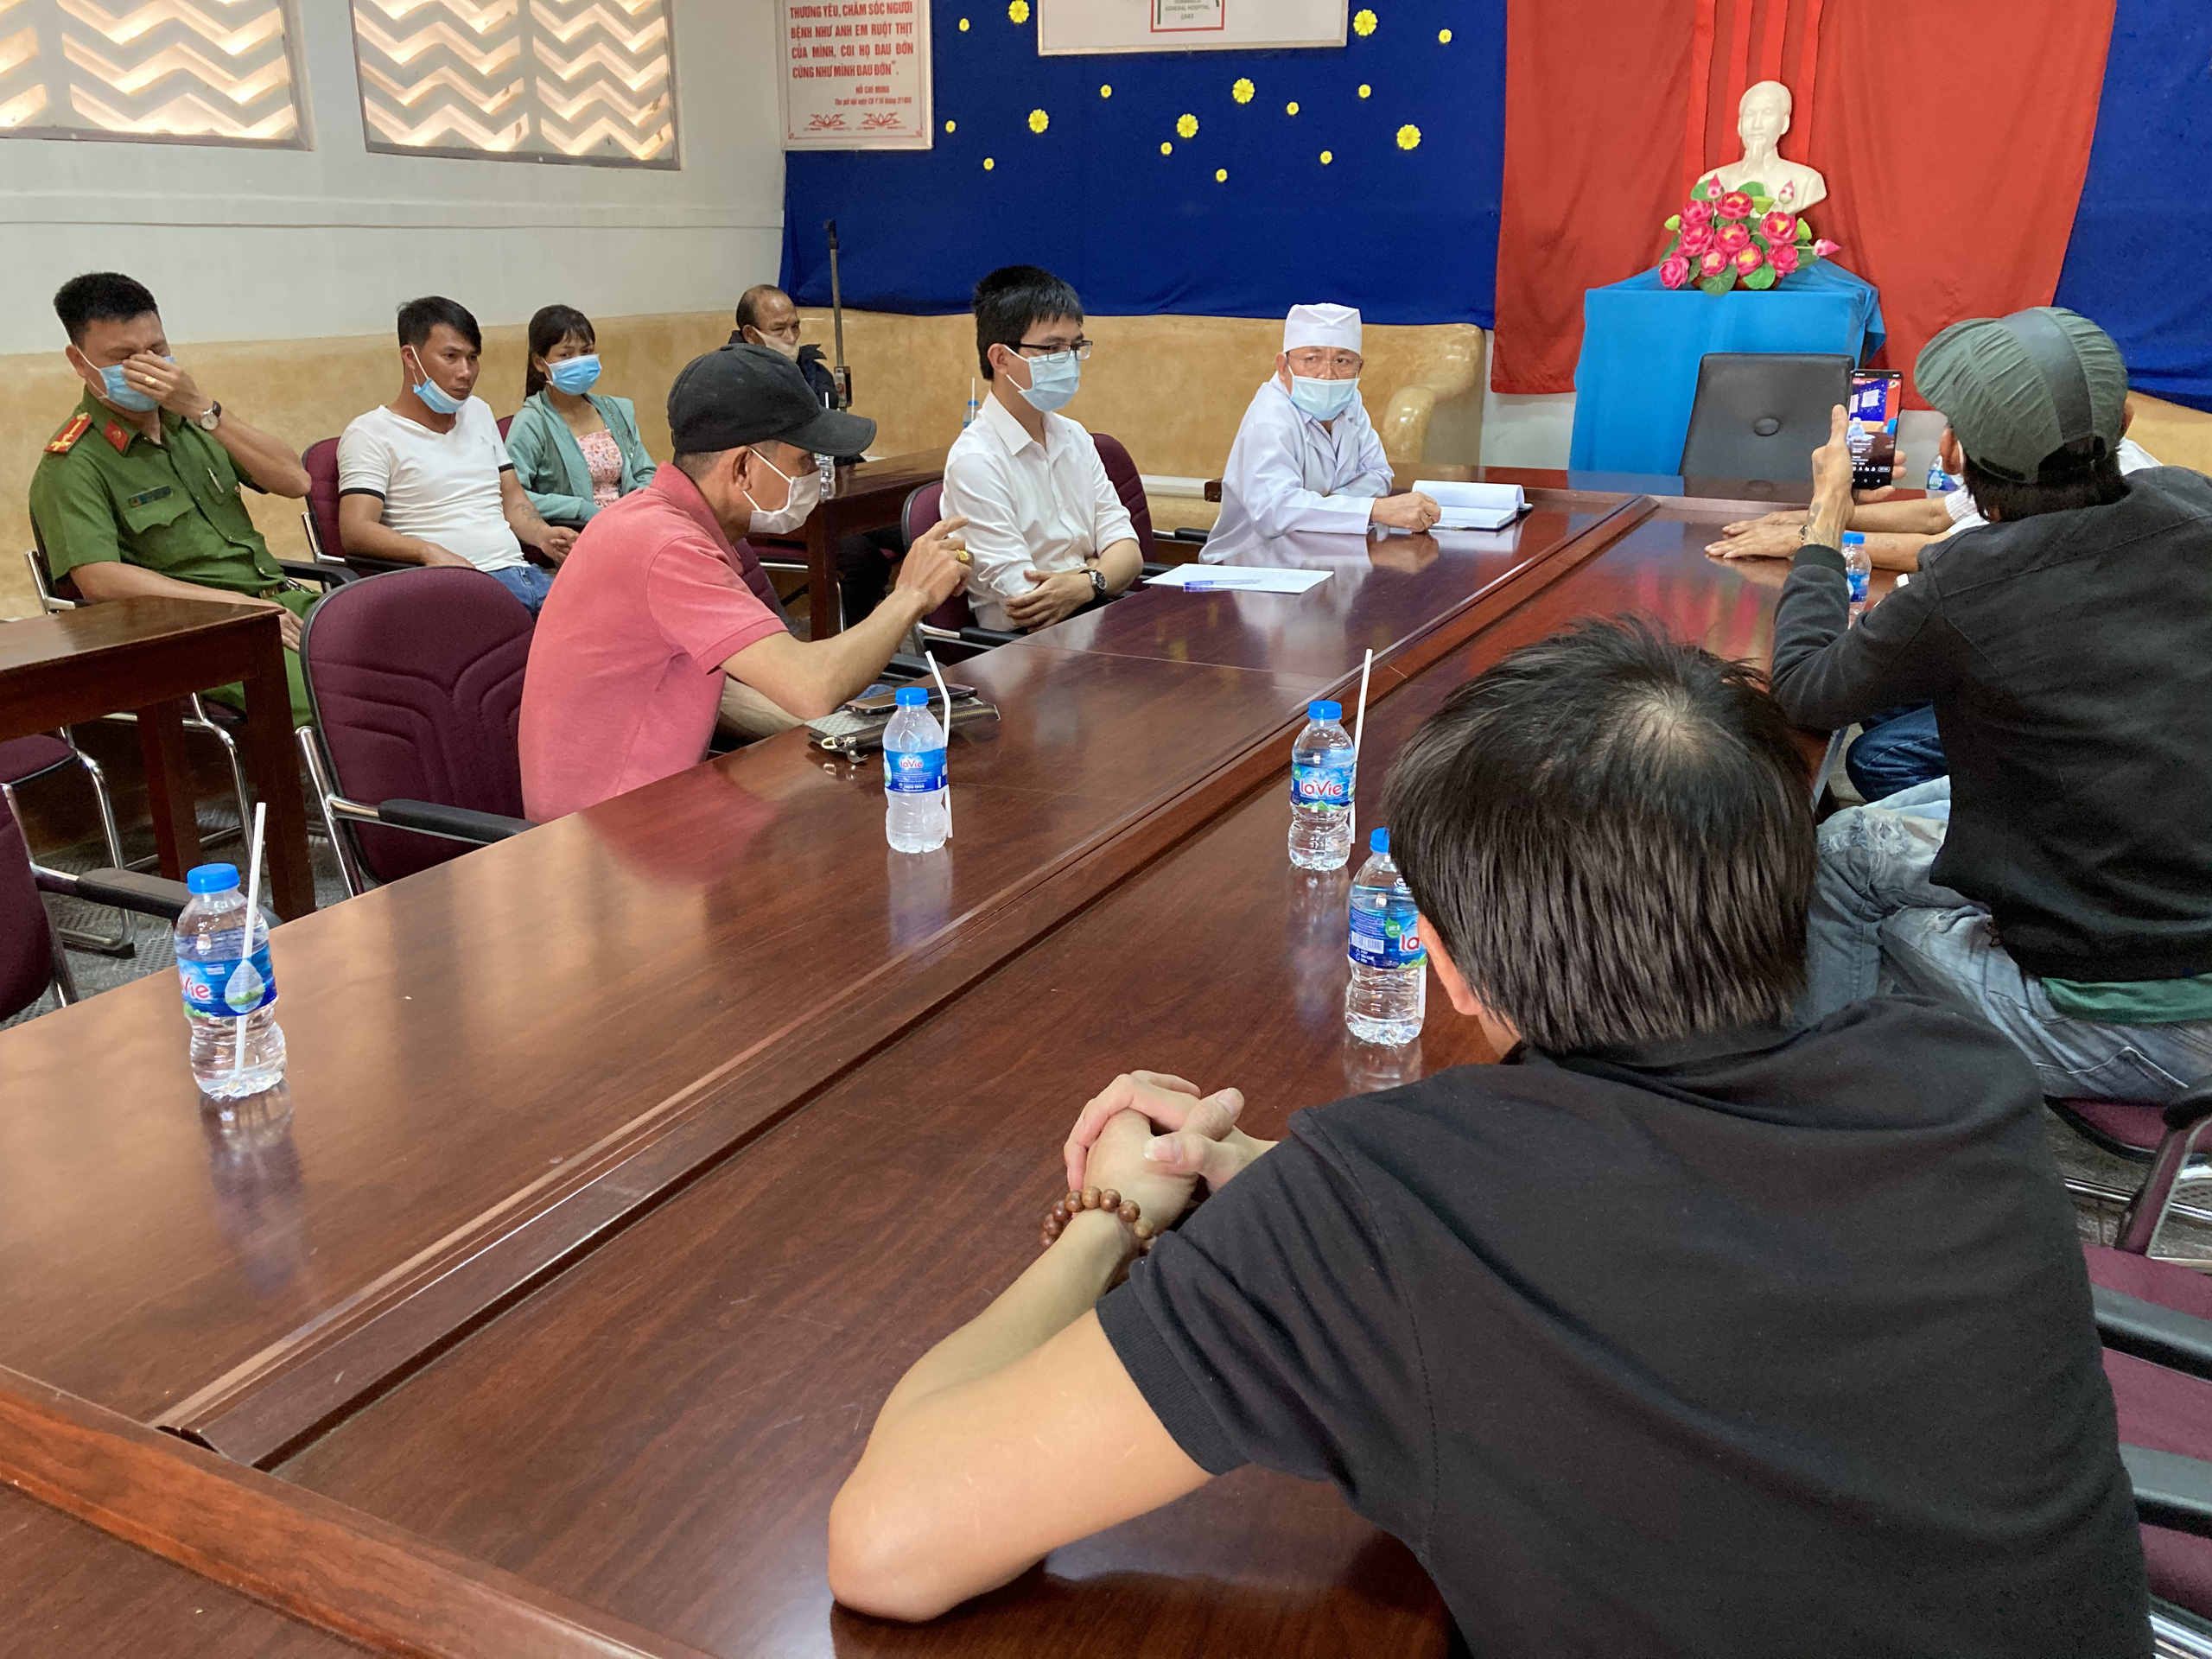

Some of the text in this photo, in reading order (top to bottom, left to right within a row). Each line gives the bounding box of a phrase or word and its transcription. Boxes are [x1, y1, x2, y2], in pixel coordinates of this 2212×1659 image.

[790, 5, 821, 18] THƯƠNG
[823, 3, 842, 18] YÊU,
[842, 2, 867, 16] CHĂM
[868, 1, 885, 16] SÓC
[791, 21, 912, 41] BỆNH NHƯ ANH EM RUỘT THỊT
[791, 41, 913, 59] CỦA MÌNH, COI HỌ ĐAU ĐỚN
[792, 65, 814, 78] CŨNG
[816, 65, 833, 78] NHƯ
[834, 63, 855, 77] MÌNH
[856, 64, 873, 76] ĐAU
[900, 760, 923, 768] laVie
[1300, 779, 1343, 796] laVie
